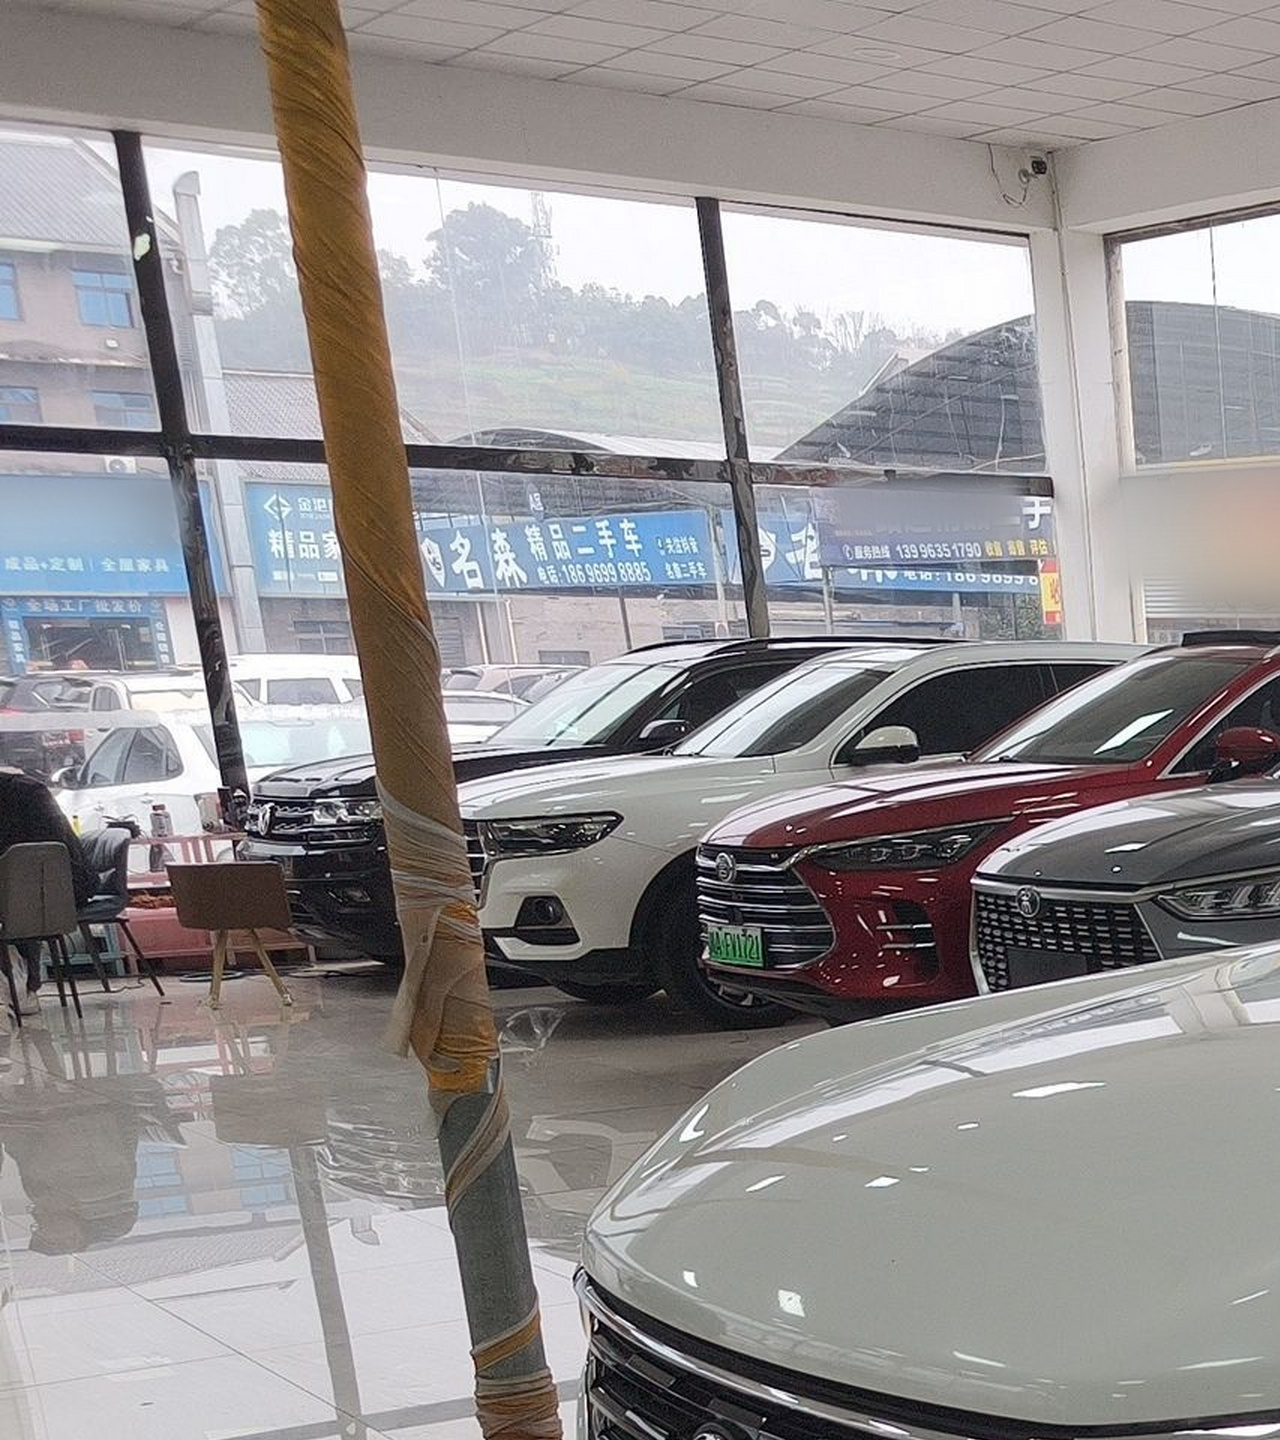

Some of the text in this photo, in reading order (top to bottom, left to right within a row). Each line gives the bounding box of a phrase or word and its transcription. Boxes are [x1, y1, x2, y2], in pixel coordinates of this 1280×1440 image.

[449, 528, 528, 589] 名森
[524, 518, 643, 561] 精品二手车
[896, 544, 919, 559] 139
[920, 543, 952, 558] 9635
[952, 542, 982, 558] 1790
